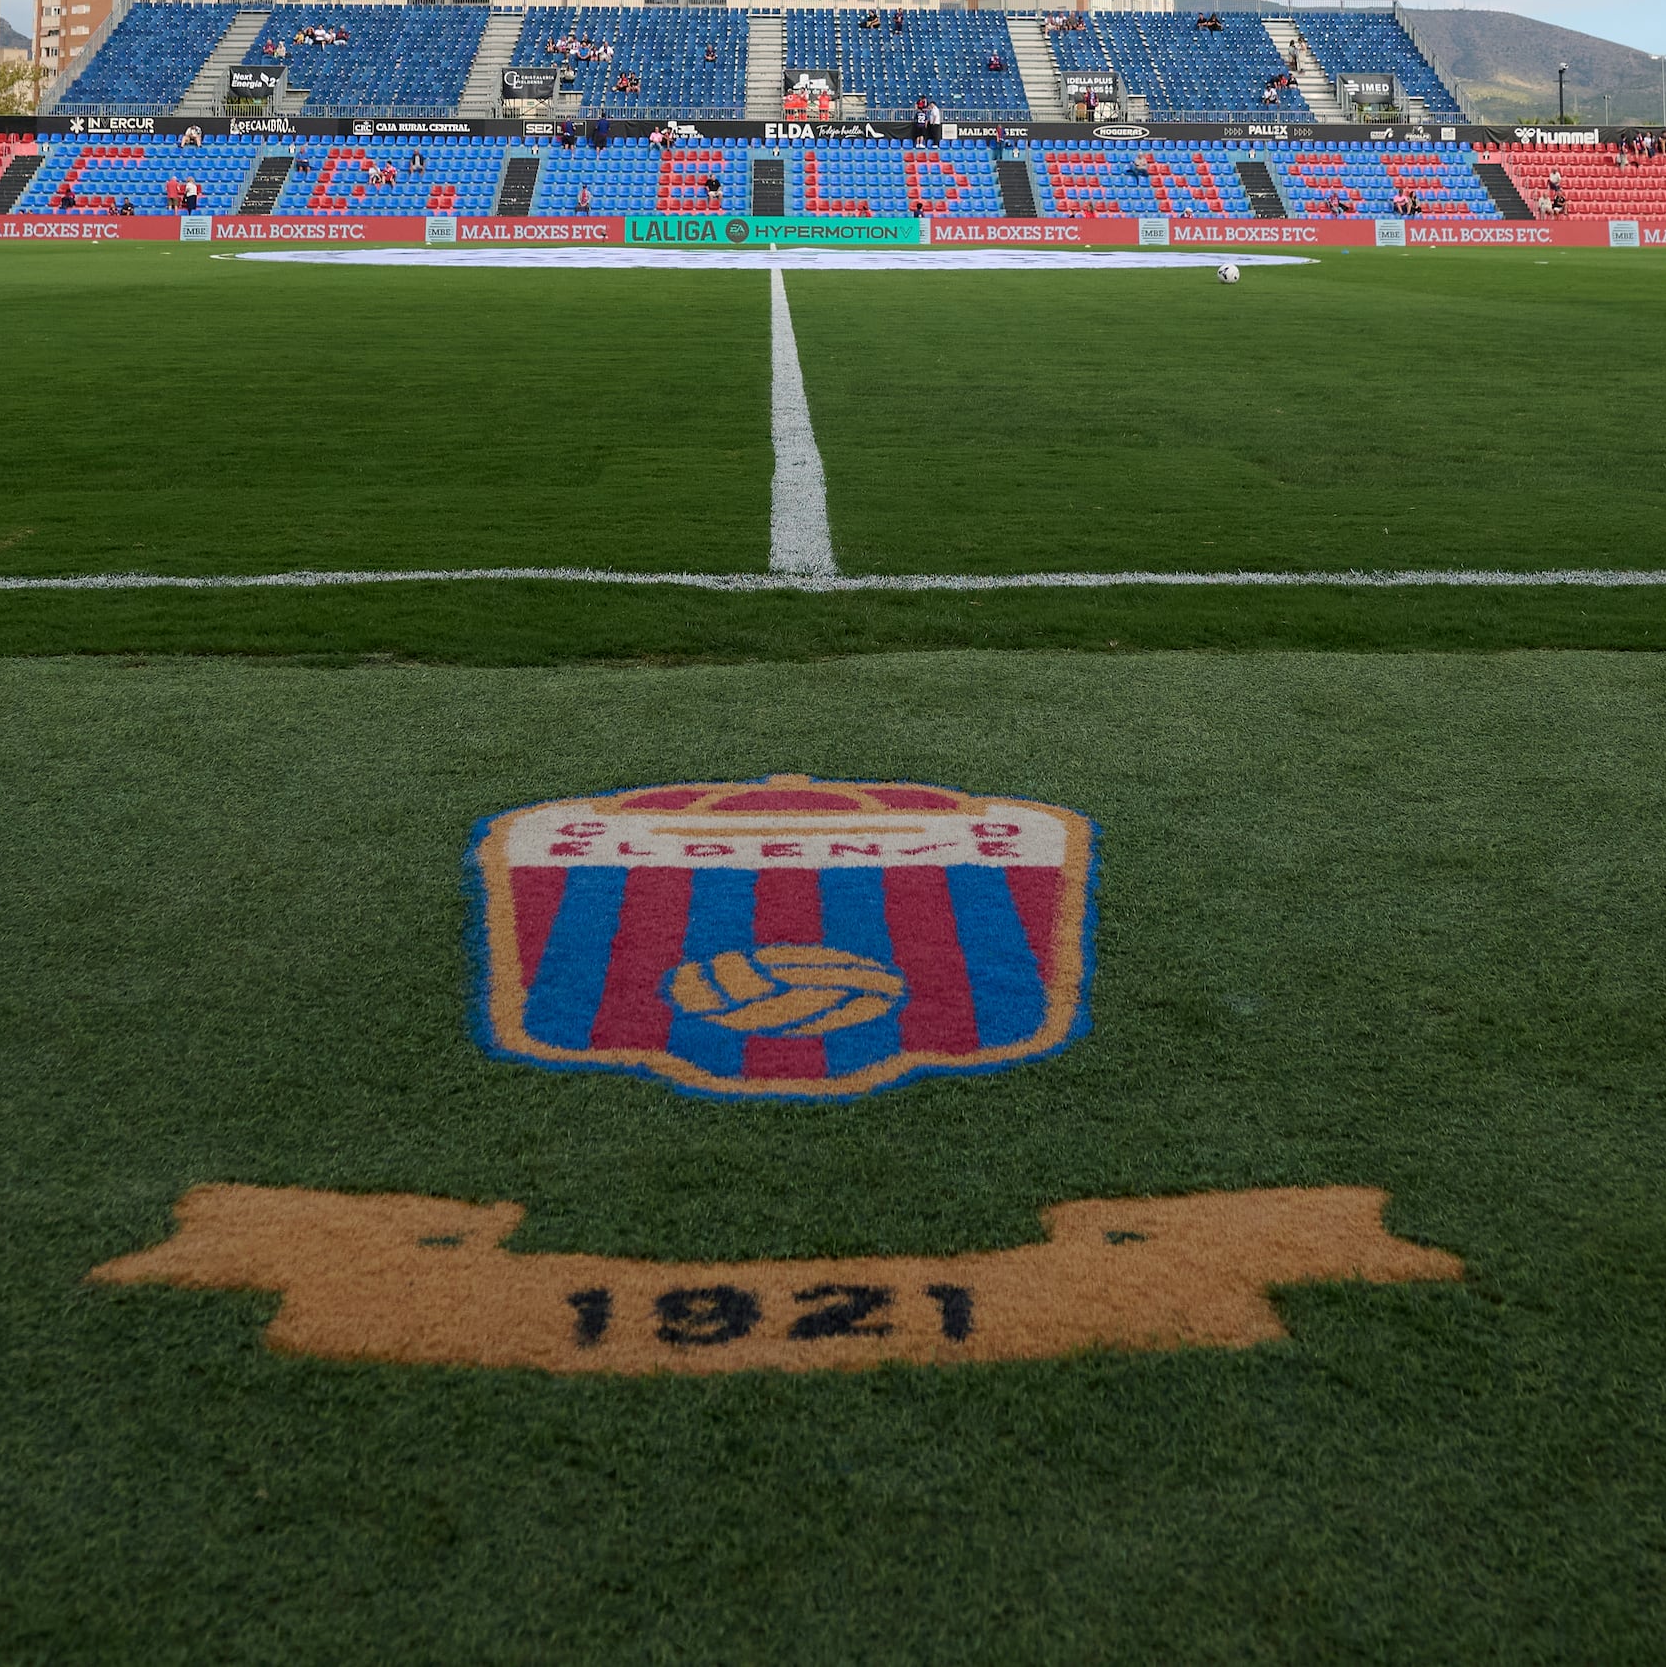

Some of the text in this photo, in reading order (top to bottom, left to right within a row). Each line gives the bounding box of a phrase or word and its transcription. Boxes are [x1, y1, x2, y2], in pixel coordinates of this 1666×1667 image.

[1362, 83, 1389, 91] IMED
[88, 118, 154, 129] INVERCUR
[918, 115, 925, 123] 22
[355, 123, 371, 132] CRC
[376, 123, 470, 132] CAJA RURAL CENTRAL
[526, 124, 553, 134] SER
[765, 123, 814, 139] ELDA
[959, 128, 982, 136] MAIL
[1100, 128, 1143, 136] NOGUERAS
[1536, 128, 1599, 145] hummel
[23, 222, 79, 238] BOXES
[82, 222, 119, 238] ETC.
[216, 224, 366, 239] MAIL BOXES ETC.
[461, 224, 608, 239] MAIL BOXES ETC.
[632, 221, 717, 241] LALIGA
[730, 224, 745, 233] EA
[935, 226, 983, 241] MAIL
[987, 226, 1041, 241] BOXES
[1044, 226, 1080, 241] ETC.
[1174, 227, 1318, 241] MAIL BOXES ETC.
[1410, 228, 1552, 242] MAIL BOXES ETC.
[565, 1282, 974, 1350] 1921
